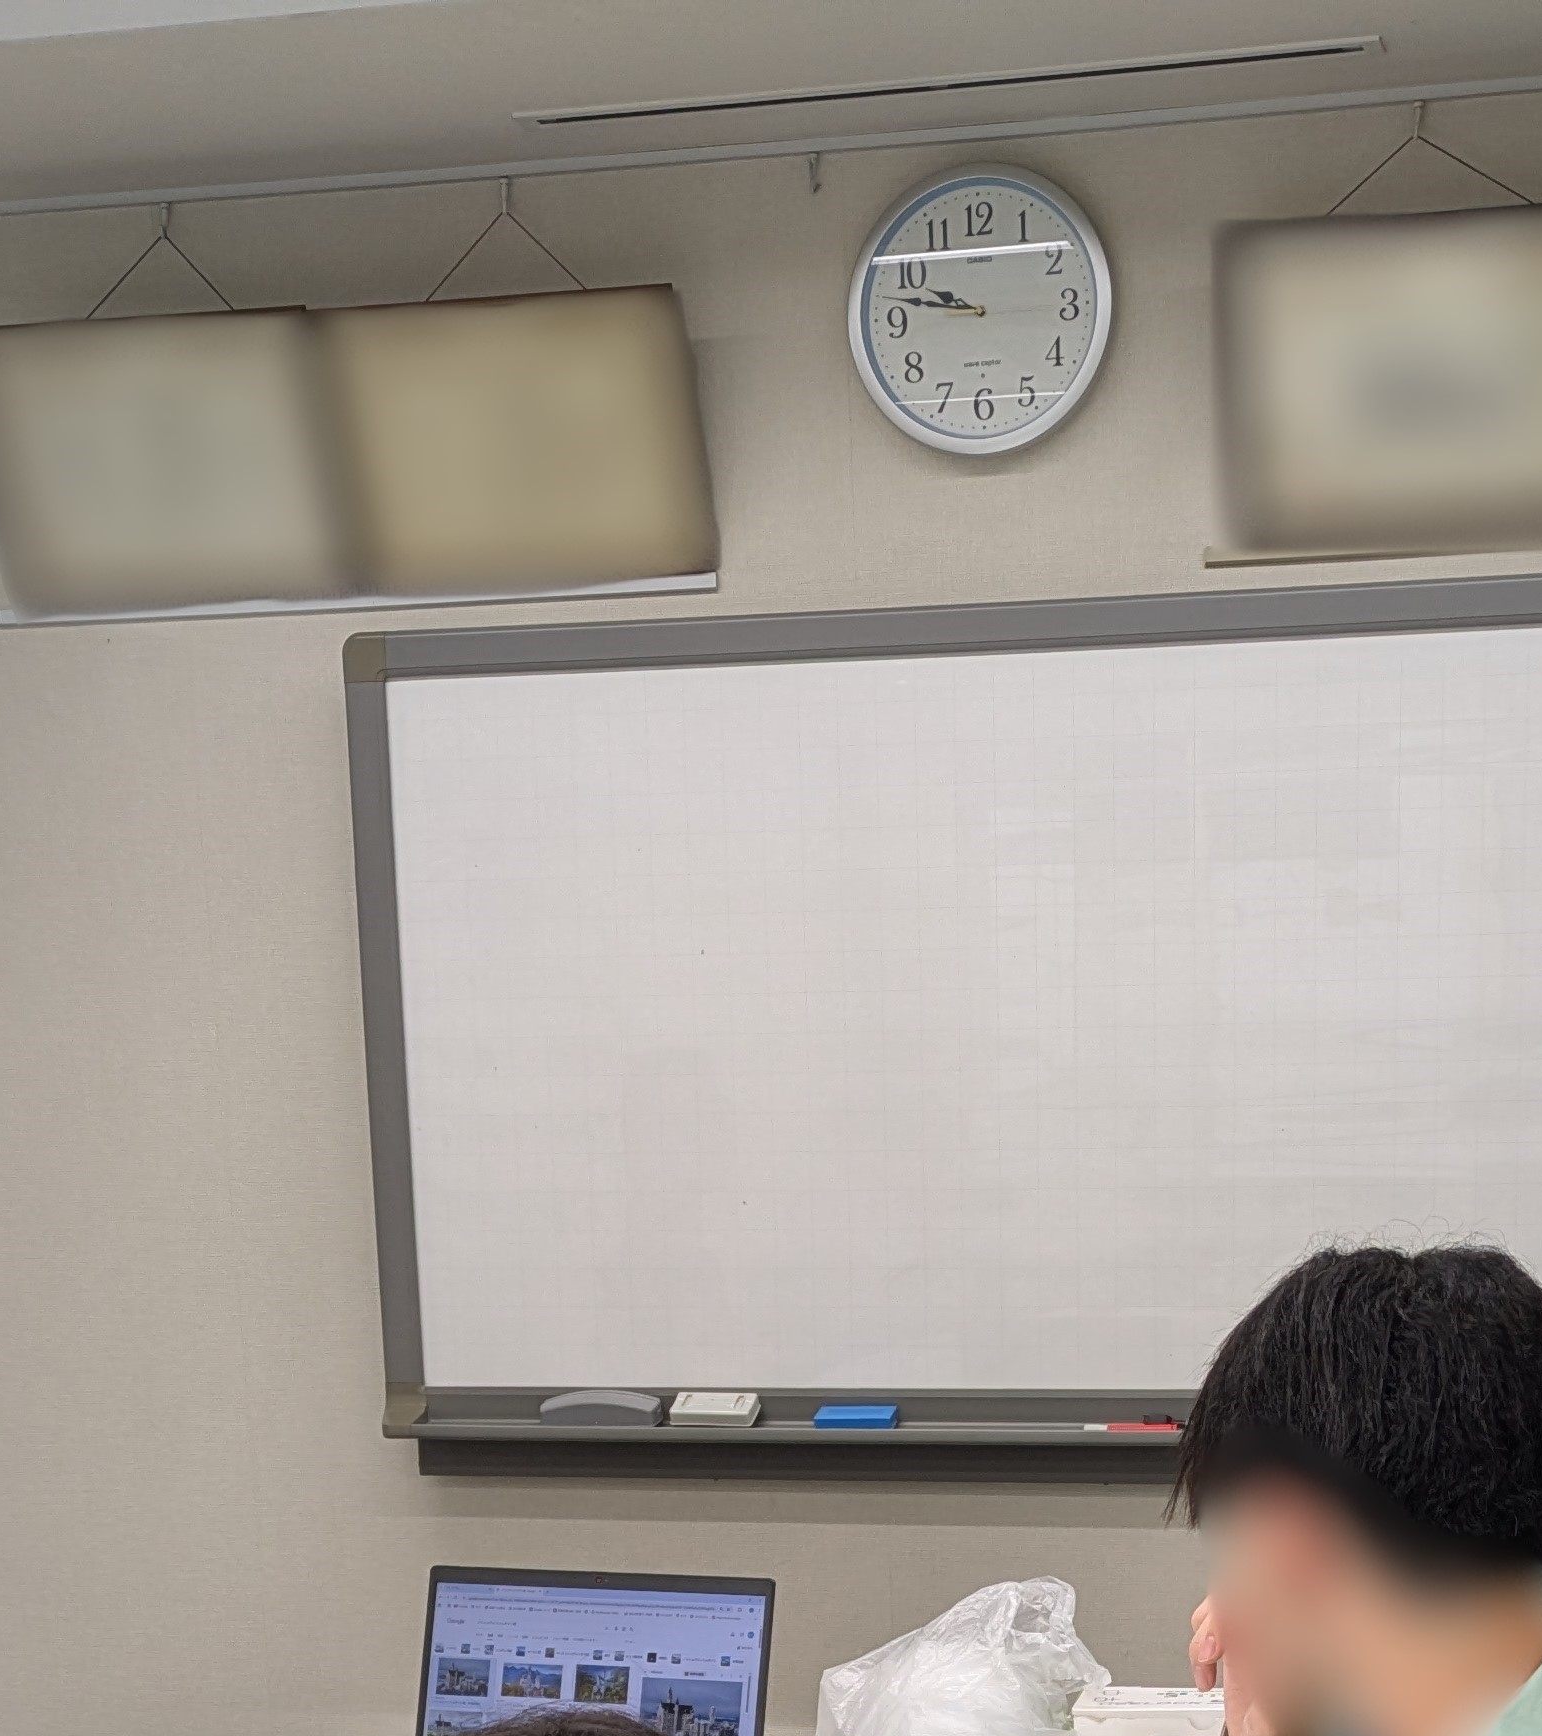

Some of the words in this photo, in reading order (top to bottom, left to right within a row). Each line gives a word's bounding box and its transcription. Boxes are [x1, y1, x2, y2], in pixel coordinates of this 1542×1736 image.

[926, 218, 951, 250] 11
[964, 202, 993, 236] 12
[1018, 210, 1029, 242] 1
[898, 257, 927, 289] 10
[967, 256, 992, 264] CASIO
[1045, 244, 1063, 275] 2
[1059, 288, 1079, 321] 3
[887, 306, 908, 339] 9
[904, 352, 924, 383] 8
[1045, 336, 1064, 367] 4
[935, 381, 953, 413] 7
[973, 388, 995, 421] 6
[1017, 375, 1036, 407] 5
